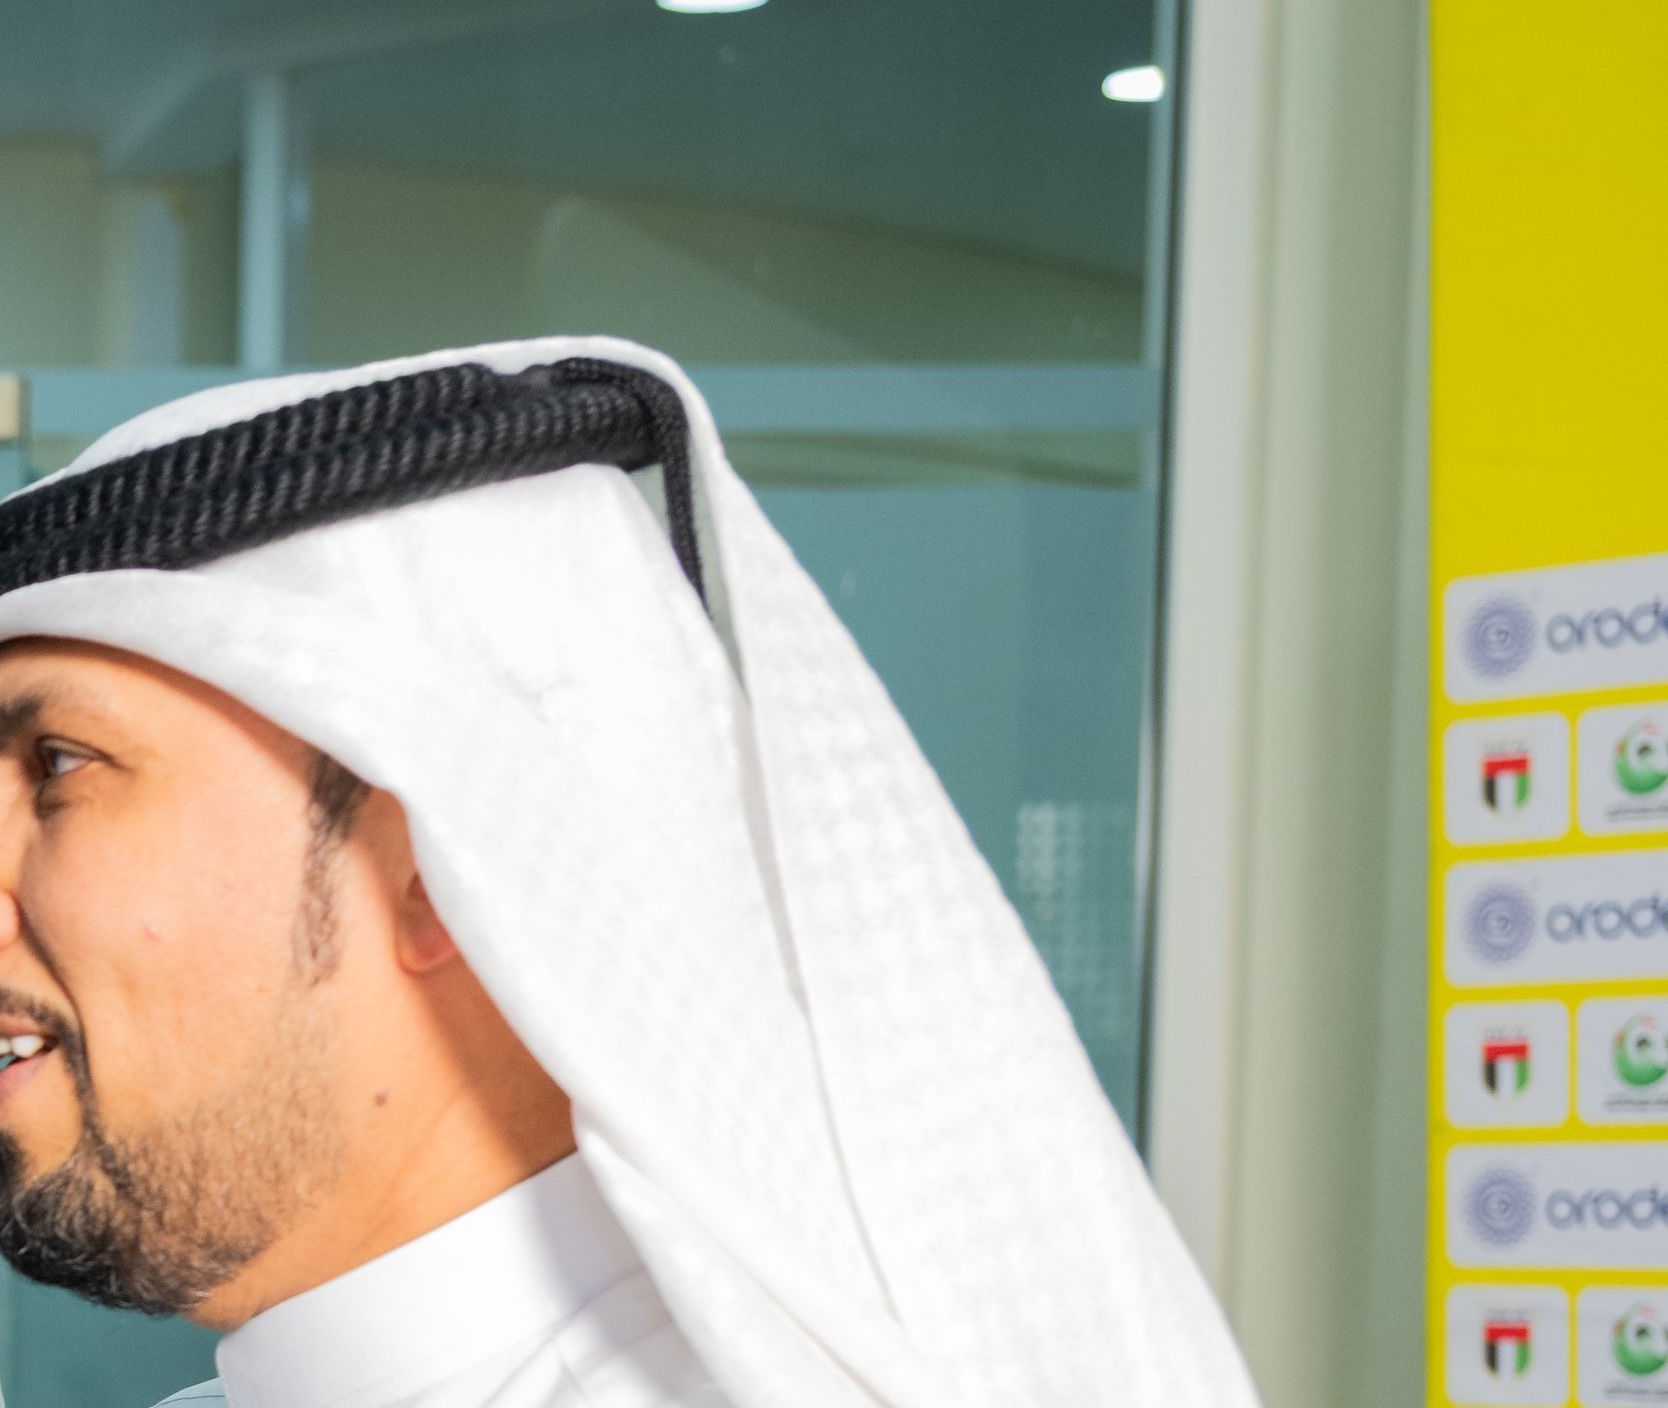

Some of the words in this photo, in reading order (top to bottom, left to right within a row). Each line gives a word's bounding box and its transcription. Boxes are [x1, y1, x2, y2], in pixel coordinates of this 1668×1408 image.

[1546, 597, 1668, 654] orod
[1545, 895, 1668, 942] orod
[1545, 1182, 1668, 1230] orod
